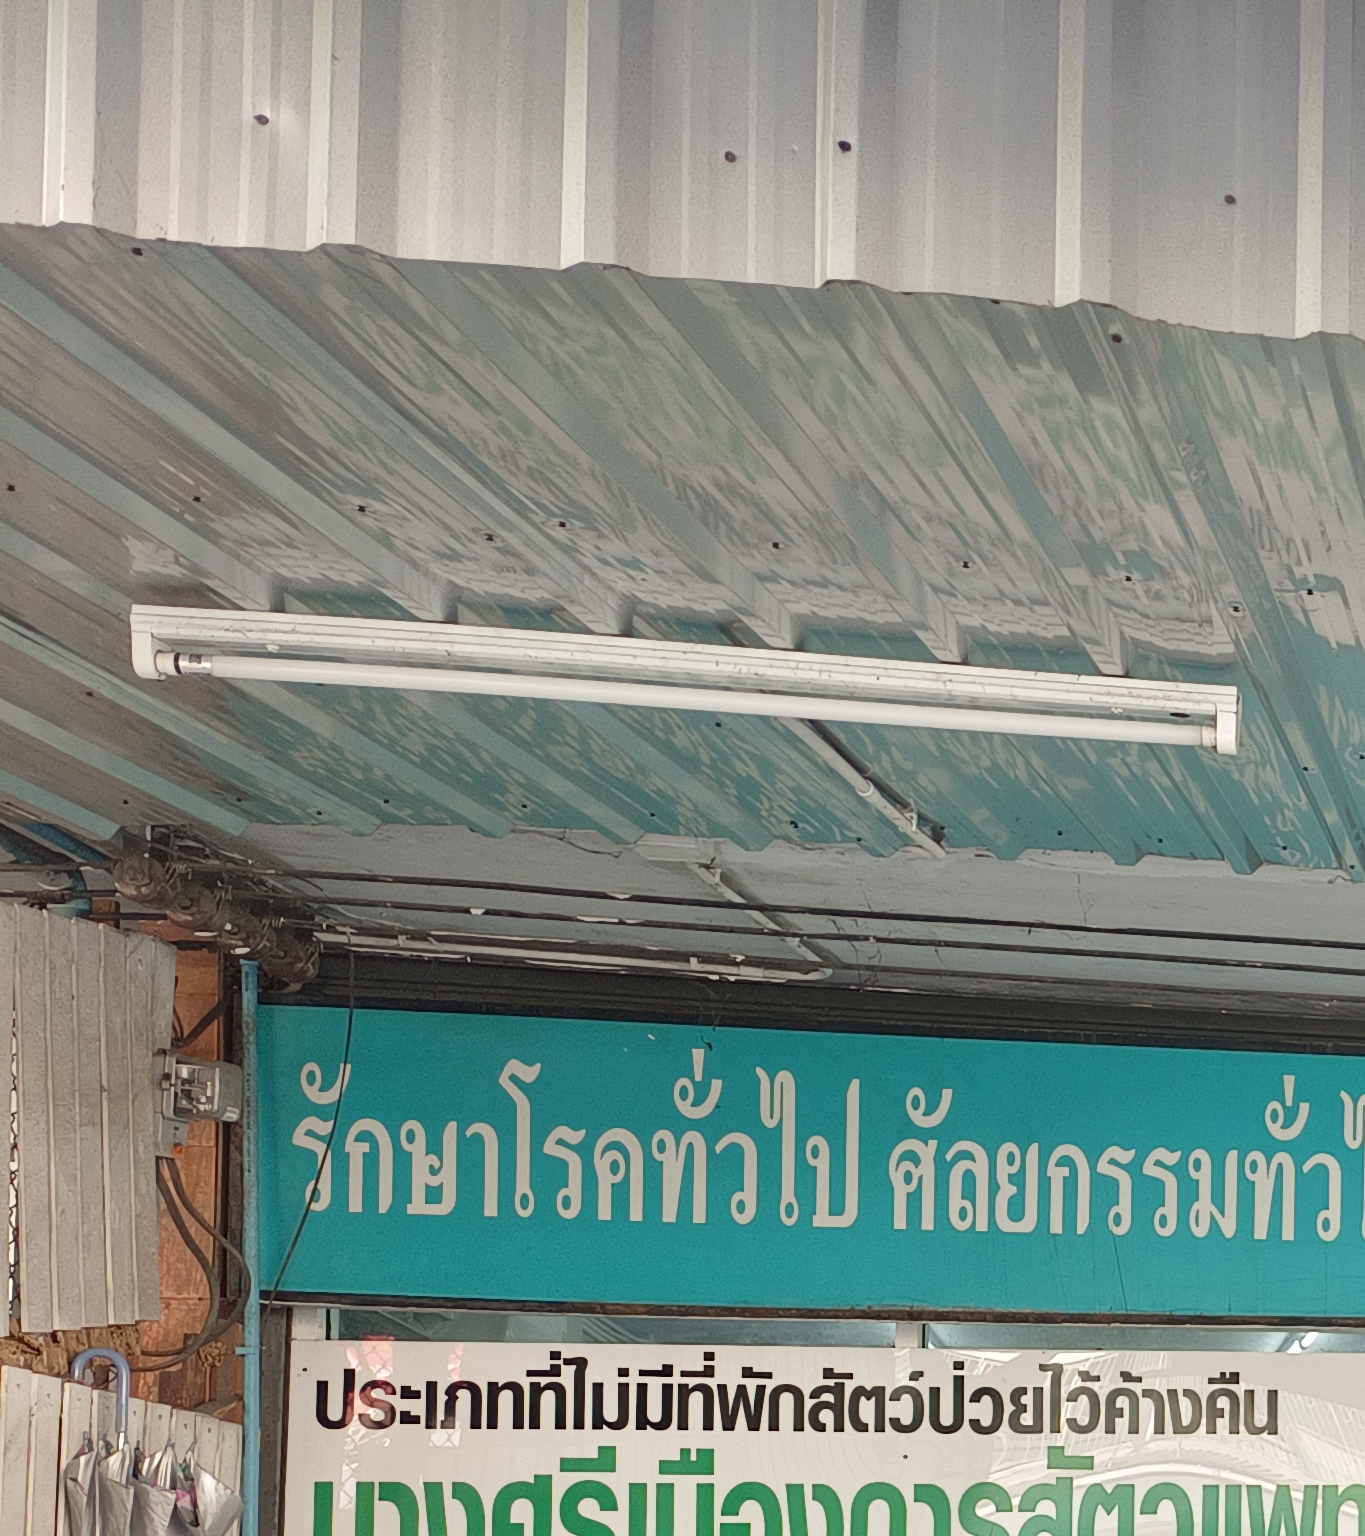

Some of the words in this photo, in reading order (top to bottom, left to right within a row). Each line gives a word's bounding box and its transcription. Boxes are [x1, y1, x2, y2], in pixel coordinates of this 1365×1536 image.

[293, 1049, 860, 1228] รักษาโรคทั่วไป
[315, 1350, 1279, 1436] ประเภทที่ไม่มีที่พักสัตว์ป่วยไว้ค้างคืน
